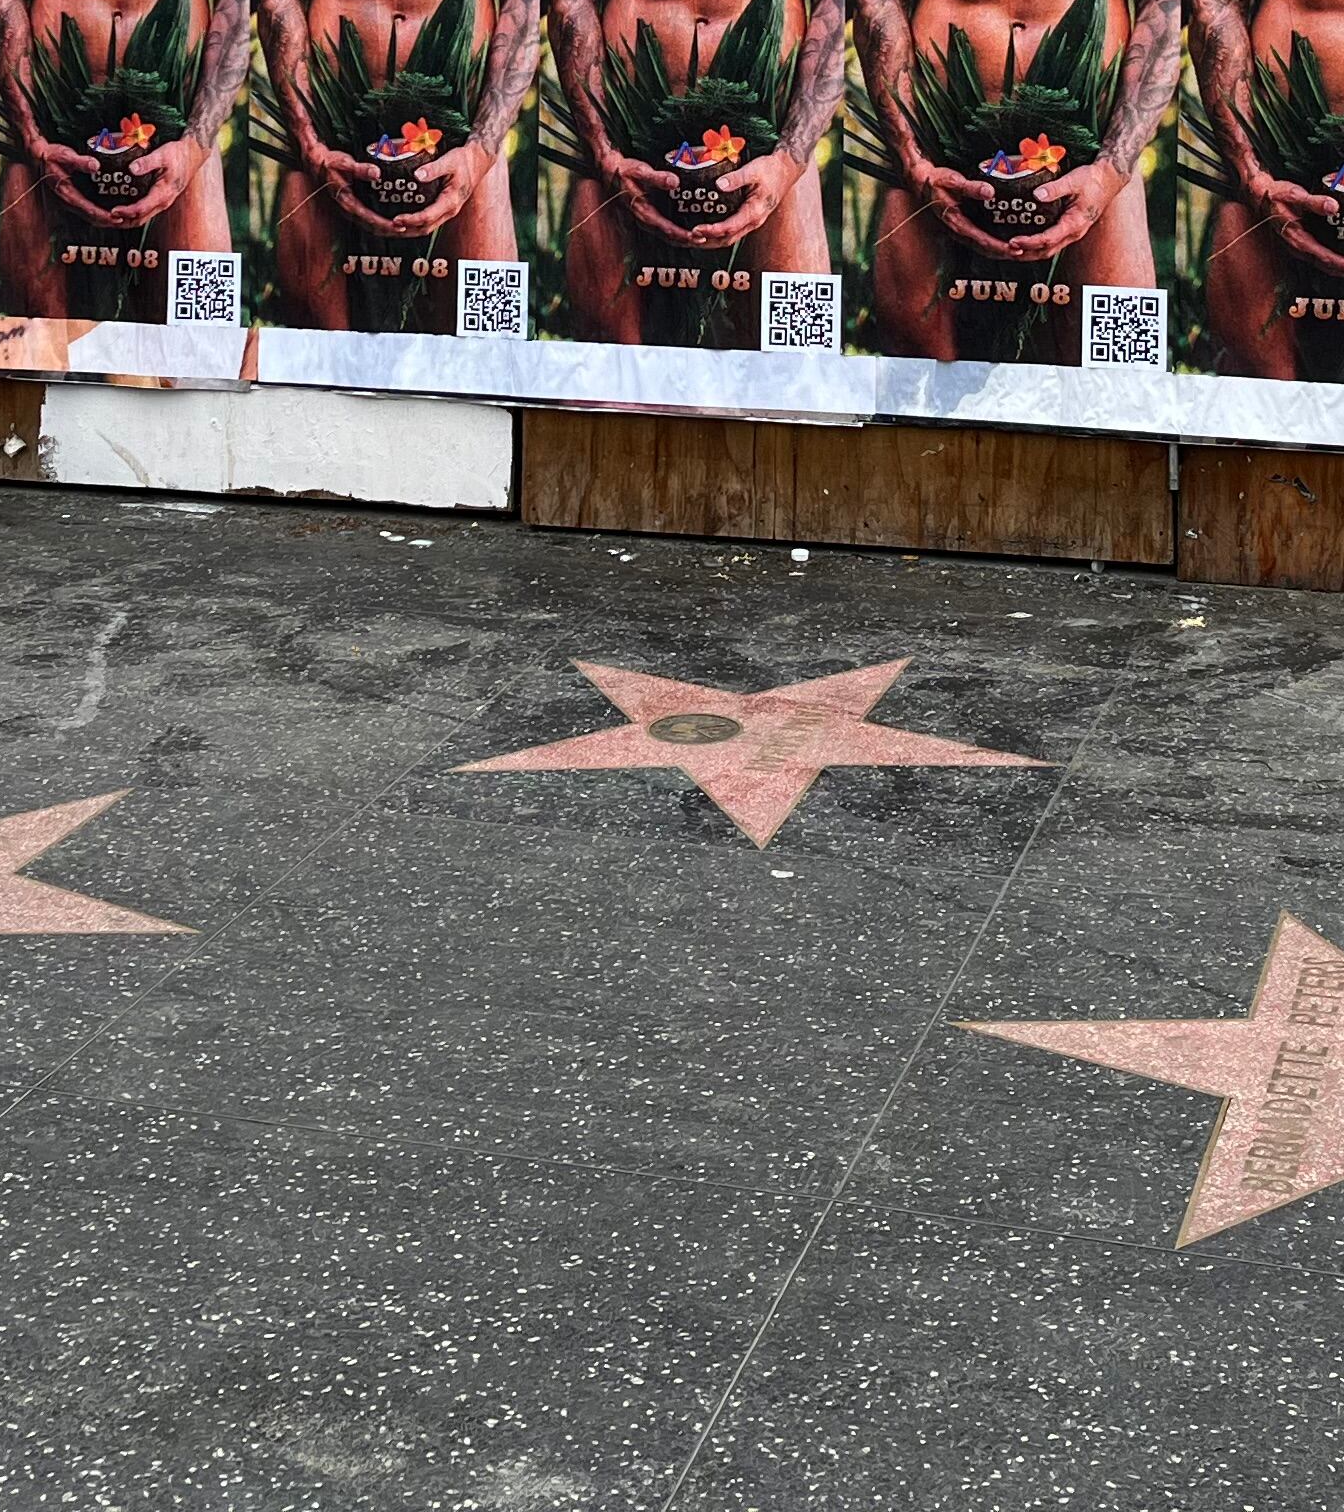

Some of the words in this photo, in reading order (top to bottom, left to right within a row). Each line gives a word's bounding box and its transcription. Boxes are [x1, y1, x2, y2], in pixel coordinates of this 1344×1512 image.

[61, 245, 119, 266] JUN
[127, 248, 159, 268] 08
[342, 255, 403, 276] JUN
[412, 258, 449, 277] 08
[636, 267, 701, 288] JUN
[711, 269, 751, 291] 08
[948, 279, 1018, 302] JUN
[1029, 283, 1071, 305] 08
